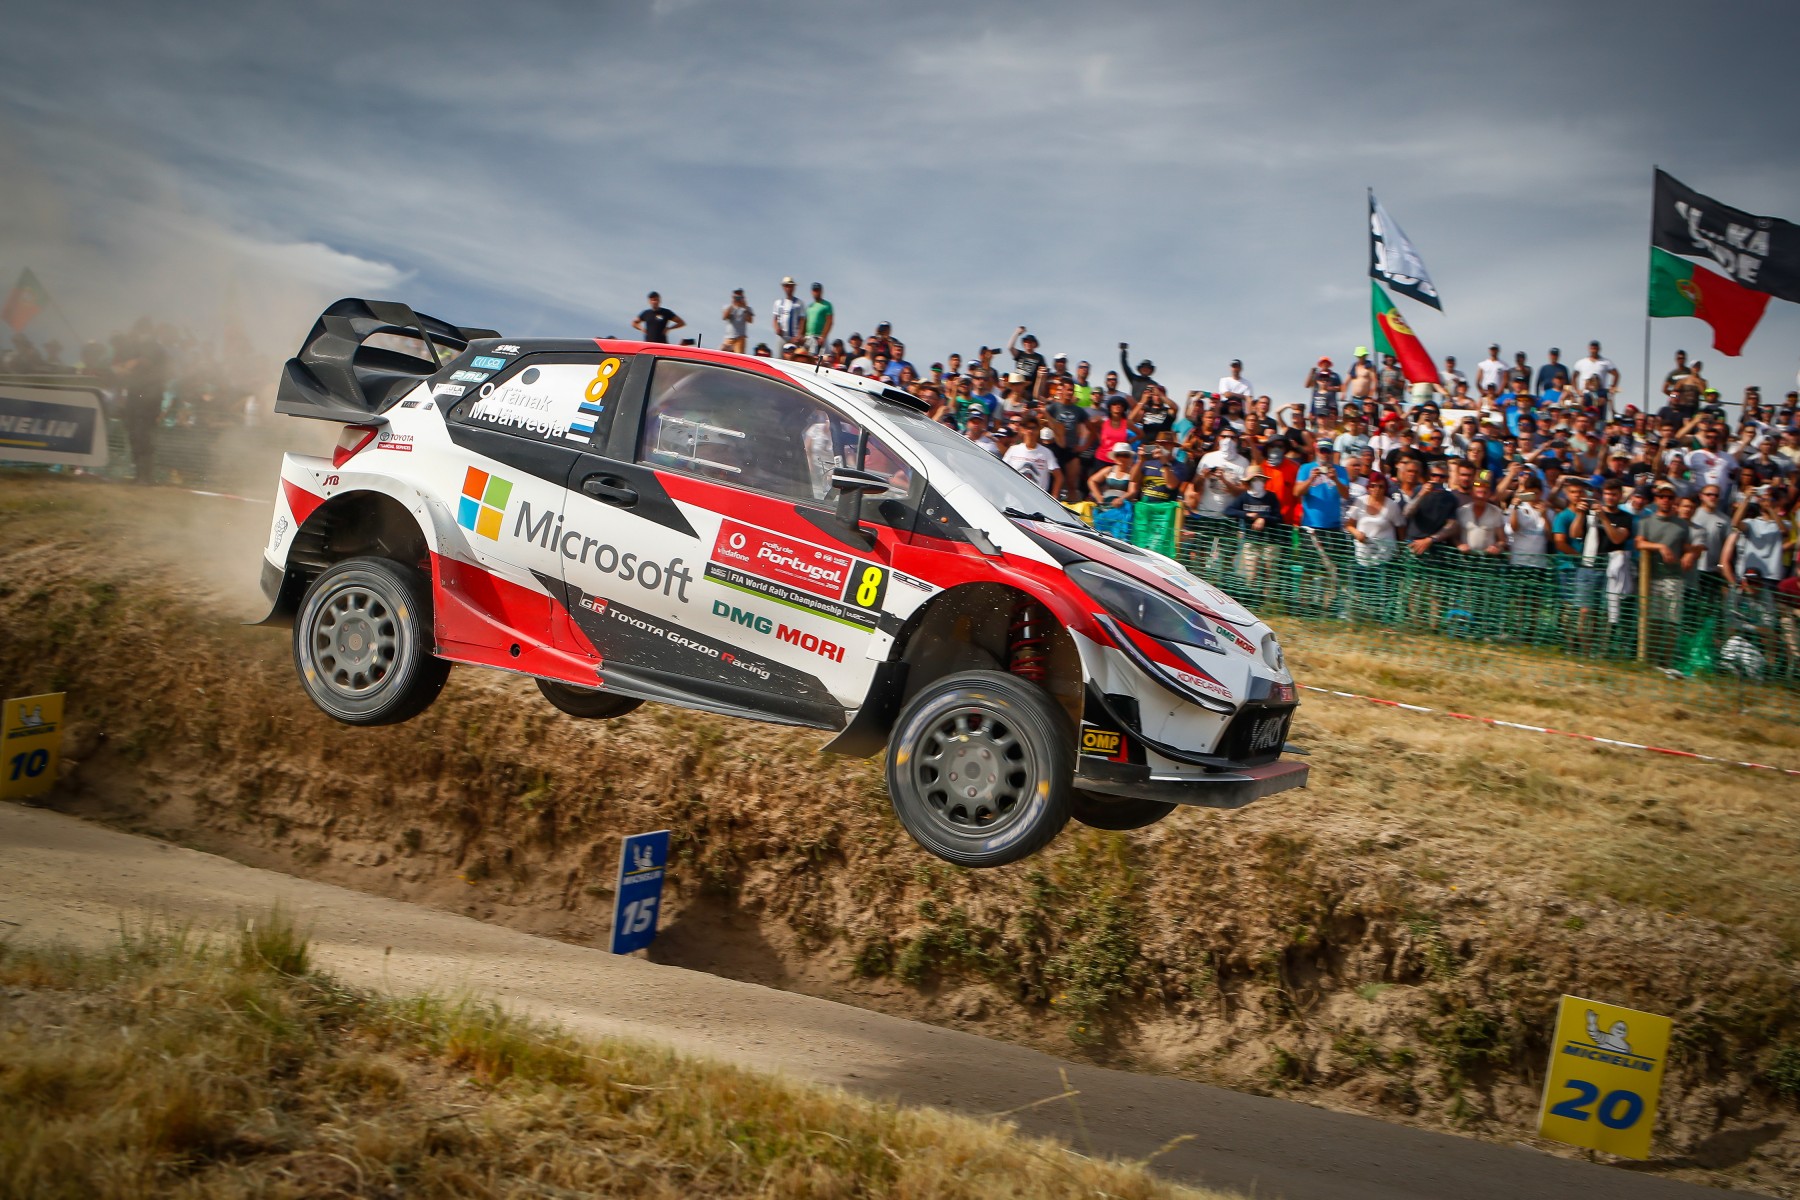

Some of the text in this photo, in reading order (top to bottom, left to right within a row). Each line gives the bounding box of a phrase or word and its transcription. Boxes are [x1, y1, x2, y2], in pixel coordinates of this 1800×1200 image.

[585, 357, 621, 402] 8
[391, 433, 414, 442] TOYOTA
[323, 474, 340, 486] JTB
[513, 500, 693, 604] Microsoft
[717, 547, 750, 563] vodafone
[762, 541, 794, 555] rally de
[757, 547, 842, 583] Portugal
[731, 573, 744, 585] FIA
[746, 577, 768, 592] World
[769, 585, 789, 600] Rally
[789, 591, 842, 618] Championship
[856, 566, 883, 607] 8
[581, 597, 606, 614] GR
[609, 608, 771, 680] TOYOTA GAZOO Racing
[711, 599, 846, 664] DMG MORI
[1216, 626, 1256, 655] DMG MORI
[1177, 672, 1233, 699] KONECRANES
[1083, 733, 1119, 749] OMP
[10, 748, 49, 781] 10
[622, 897, 657, 935] 15
[1562, 1045, 1654, 1072] MICHELIN
[1549, 1079, 1645, 1130] 20
